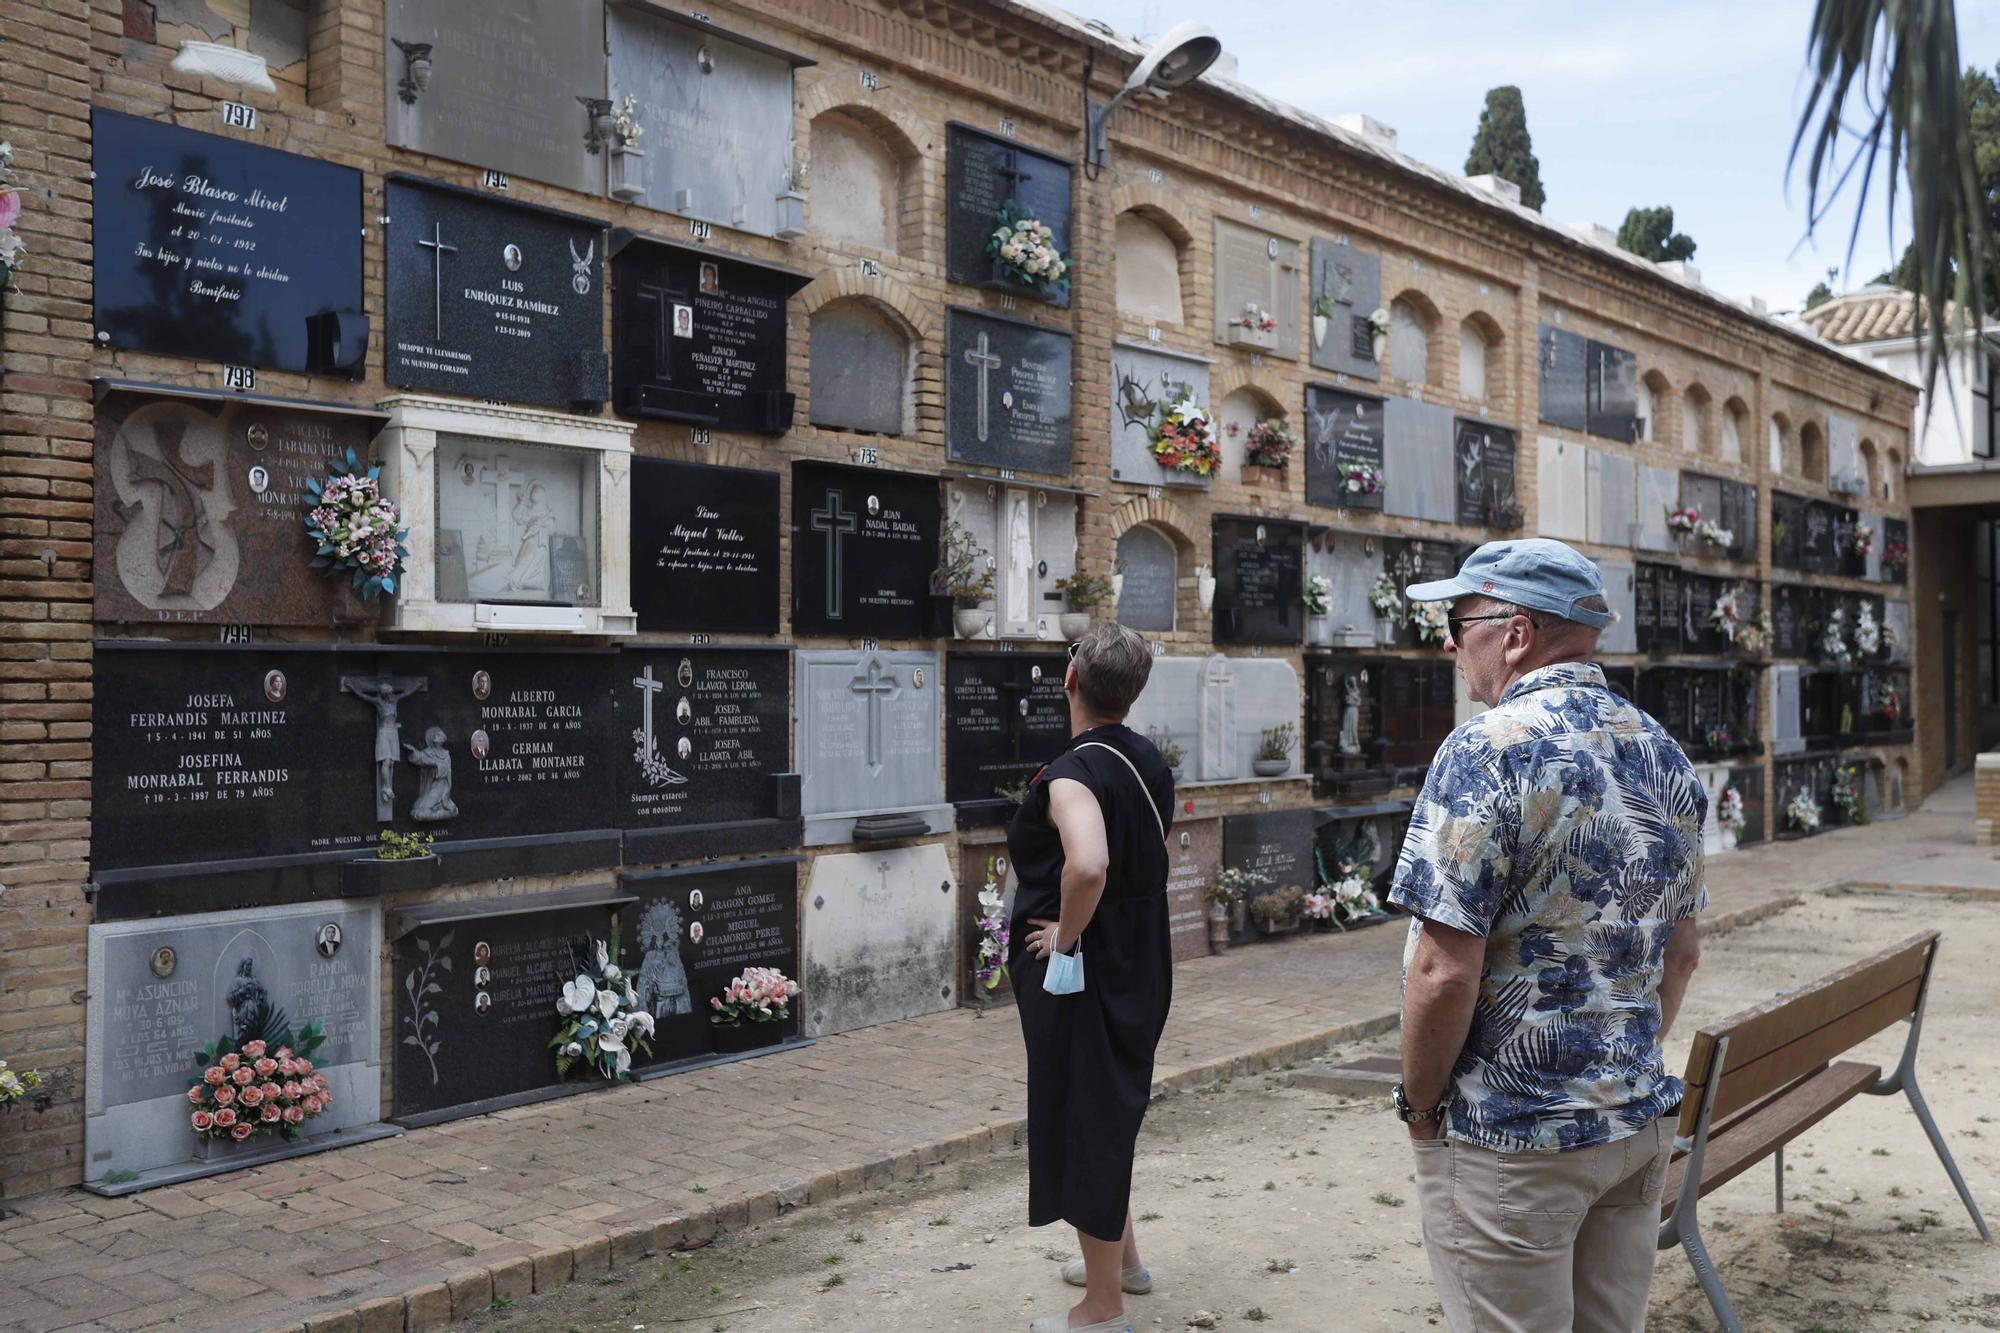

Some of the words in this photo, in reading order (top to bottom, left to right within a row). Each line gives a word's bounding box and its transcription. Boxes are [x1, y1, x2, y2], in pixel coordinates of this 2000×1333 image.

[225, 103, 253, 128] 797
[134, 166, 176, 190] José
[183, 175, 239, 202] Blasco
[485, 170, 508, 188] 794
[173, 202, 206, 219] Murió
[209, 210, 254, 228] fusilado
[171, 226, 183, 238] el
[188, 230, 200, 240] 20
[210, 235, 222, 245] 01
[234, 238, 256, 251] 1942
[134, 242, 152, 258] Tus
[158, 247, 180, 267] hijos
[184, 257, 191, 270] y
[197, 256, 224, 271] nietos
[228, 263, 239, 274] no
[244, 262, 252, 276] te
[257, 268, 289, 283] olvidan
[502, 279, 523, 292] LUIS
[516, 300, 559, 316] RAMÍREZ
[398, 342, 424, 354] SIEMPRE
[435, 349, 471, 362] LLEVAREMOS
[712, 346, 736, 357] IGNACIO
[411, 359, 438, 370] NUESTRO
[692, 353, 722, 366] PEÑALVER
[726, 358, 755, 371] MARTINEZ
[226, 367, 254, 388] 798
[695, 505, 719, 519] Lino
[883, 510, 900, 519] JUAN
[866, 520, 889, 530] NADAL
[670, 525, 708, 542] Miguel
[716, 528, 745, 541] Valles
[706, 670, 748, 679] FRANCISCO
[697, 681, 727, 690] LLAVATA
[732, 681, 757, 690] LERMA
[187, 694, 234, 708] JOSEFA
[510, 691, 555, 702] ALBERTO
[482, 706, 537, 719] MONRABAL
[547, 705, 582, 717] GARCIA
[714, 705, 740, 714] JOSEFA
[131, 712, 208, 727] FERRANDIS
[221, 711, 286, 726] MARTINEZ
[565, 720, 581, 729] AÑOS
[695, 717, 712, 726] ABIL
[719, 715, 759, 725] FAMBUENA
[215, 730, 225, 740] DE
[250, 728, 271, 738] AÑOS
[512, 742, 553, 755] GERMAN
[714, 740, 740, 749] JOSEFA
[178, 754, 242, 769] JOSEFINA
[700, 752, 730, 761] LLAVATA
[738, 750, 754, 759] ABIL
[479, 758, 523, 771] LLABATA
[532, 756, 584, 768] MONTANER
[128, 773, 203, 790] MONRABAL
[217, 769, 288, 785] FERRANDIS
[537, 772, 545, 780] DE
[564, 770, 580, 779] AÑOS
[217, 790, 228, 799] DE
[253, 787, 274, 798] AÑOS
[632, 793, 659, 803] Siempre
[638, 807, 649, 815] con
[652, 805, 681, 814] nosotros
[735, 886, 752, 896] ANA
[711, 898, 744, 911] ARAGON
[748, 893, 776, 906] GOMEZ
[728, 919, 759, 932] MIGUEL
[706, 932, 752, 946] CHAMORRO
[755, 927, 781, 939] PEREZ
[137, 980, 198, 1000] ASUNCION
